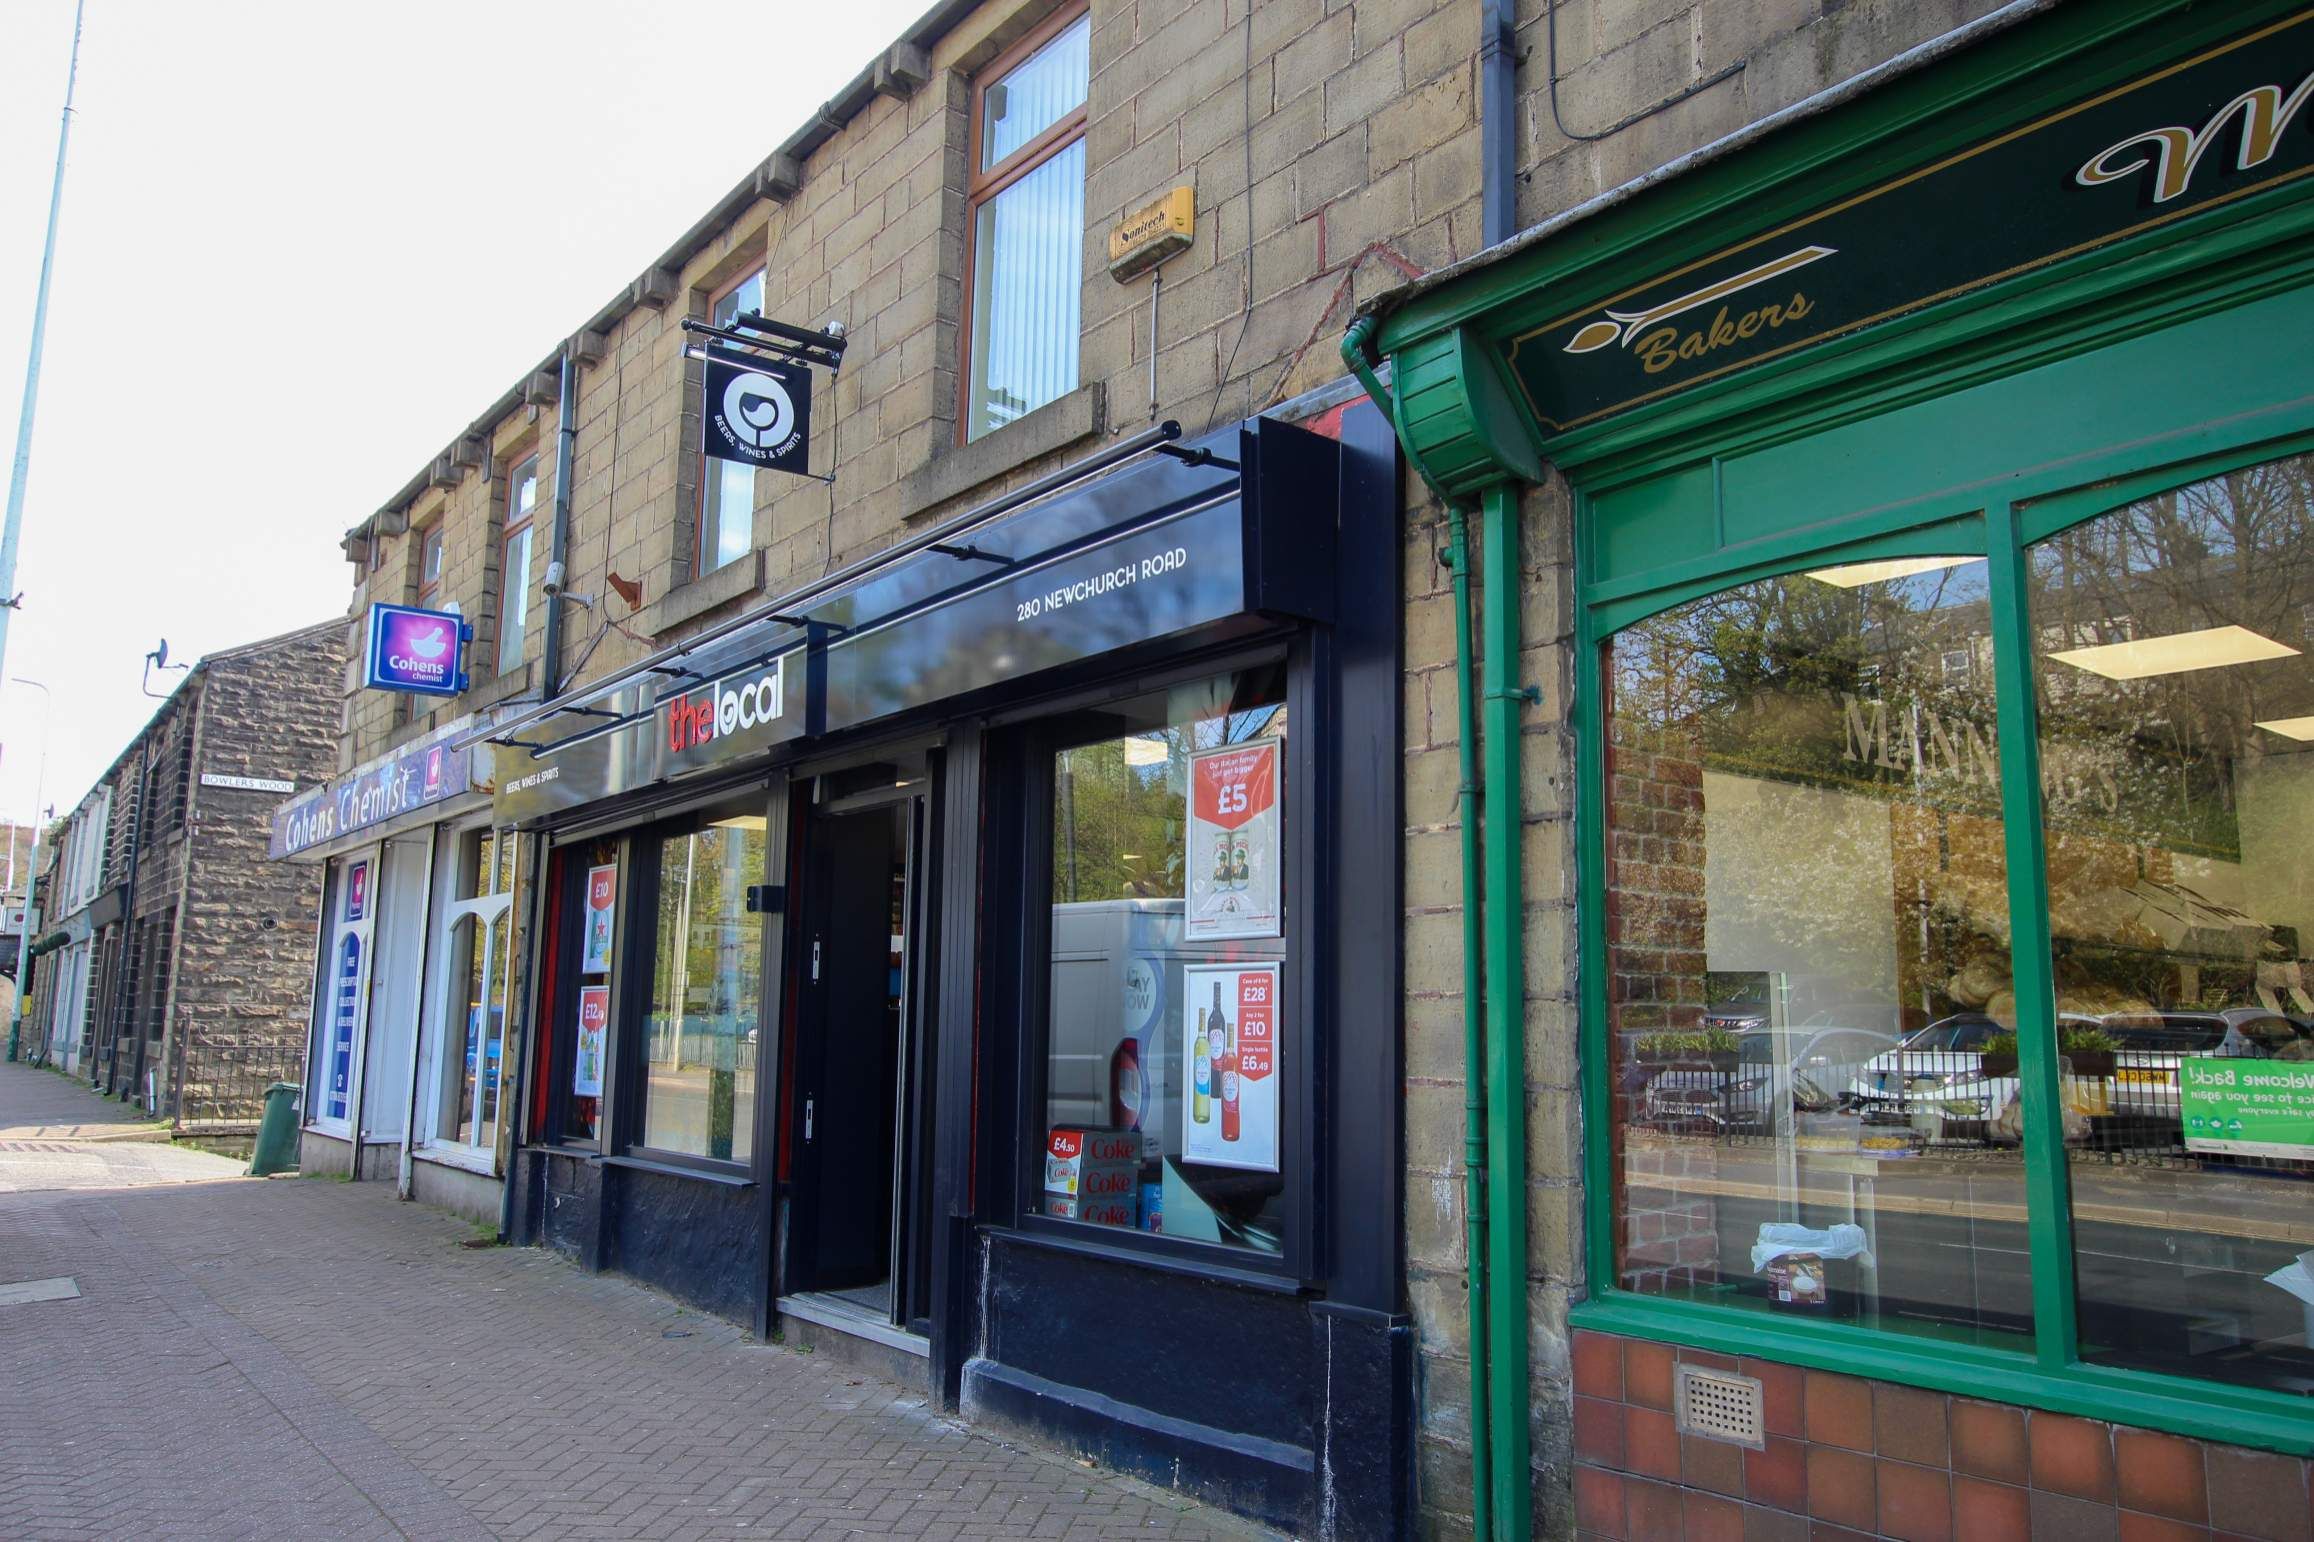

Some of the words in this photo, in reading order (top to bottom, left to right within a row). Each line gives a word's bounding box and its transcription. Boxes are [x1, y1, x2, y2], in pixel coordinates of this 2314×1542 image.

[1634, 292, 1815, 373] Bakers
[714, 415, 735, 446] BEERS,
[739, 442, 767, 459] WINES
[769, 451, 776, 459] &
[776, 432, 801, 456] SPIRITS
[1016, 598, 1041, 622] 280
[1044, 563, 1136, 612] NEWCHURCH
[1141, 547, 1187, 580] ROAD
[389, 655, 444, 674] Cohens
[412, 672, 443, 683] chemist
[204, 775, 255, 788] BOWLERS
[259, 781, 292, 791] WOOD
[1218, 783, 1248, 815] £5
[285, 806, 334, 851] Cohens
[340, 772, 410, 831] Chemist
[595, 881, 609, 898] £10
[1243, 987, 1266, 1002] £28
[1244, 1021, 1266, 1036] £10
[1242, 1055, 1268, 1071] £6.49
[1053, 1136, 1075, 1153] £4.50
[1091, 1138, 1135, 1160] Coke
[1086, 1171, 1131, 1195] Coke
[1084, 1204, 1129, 1225] Coke
